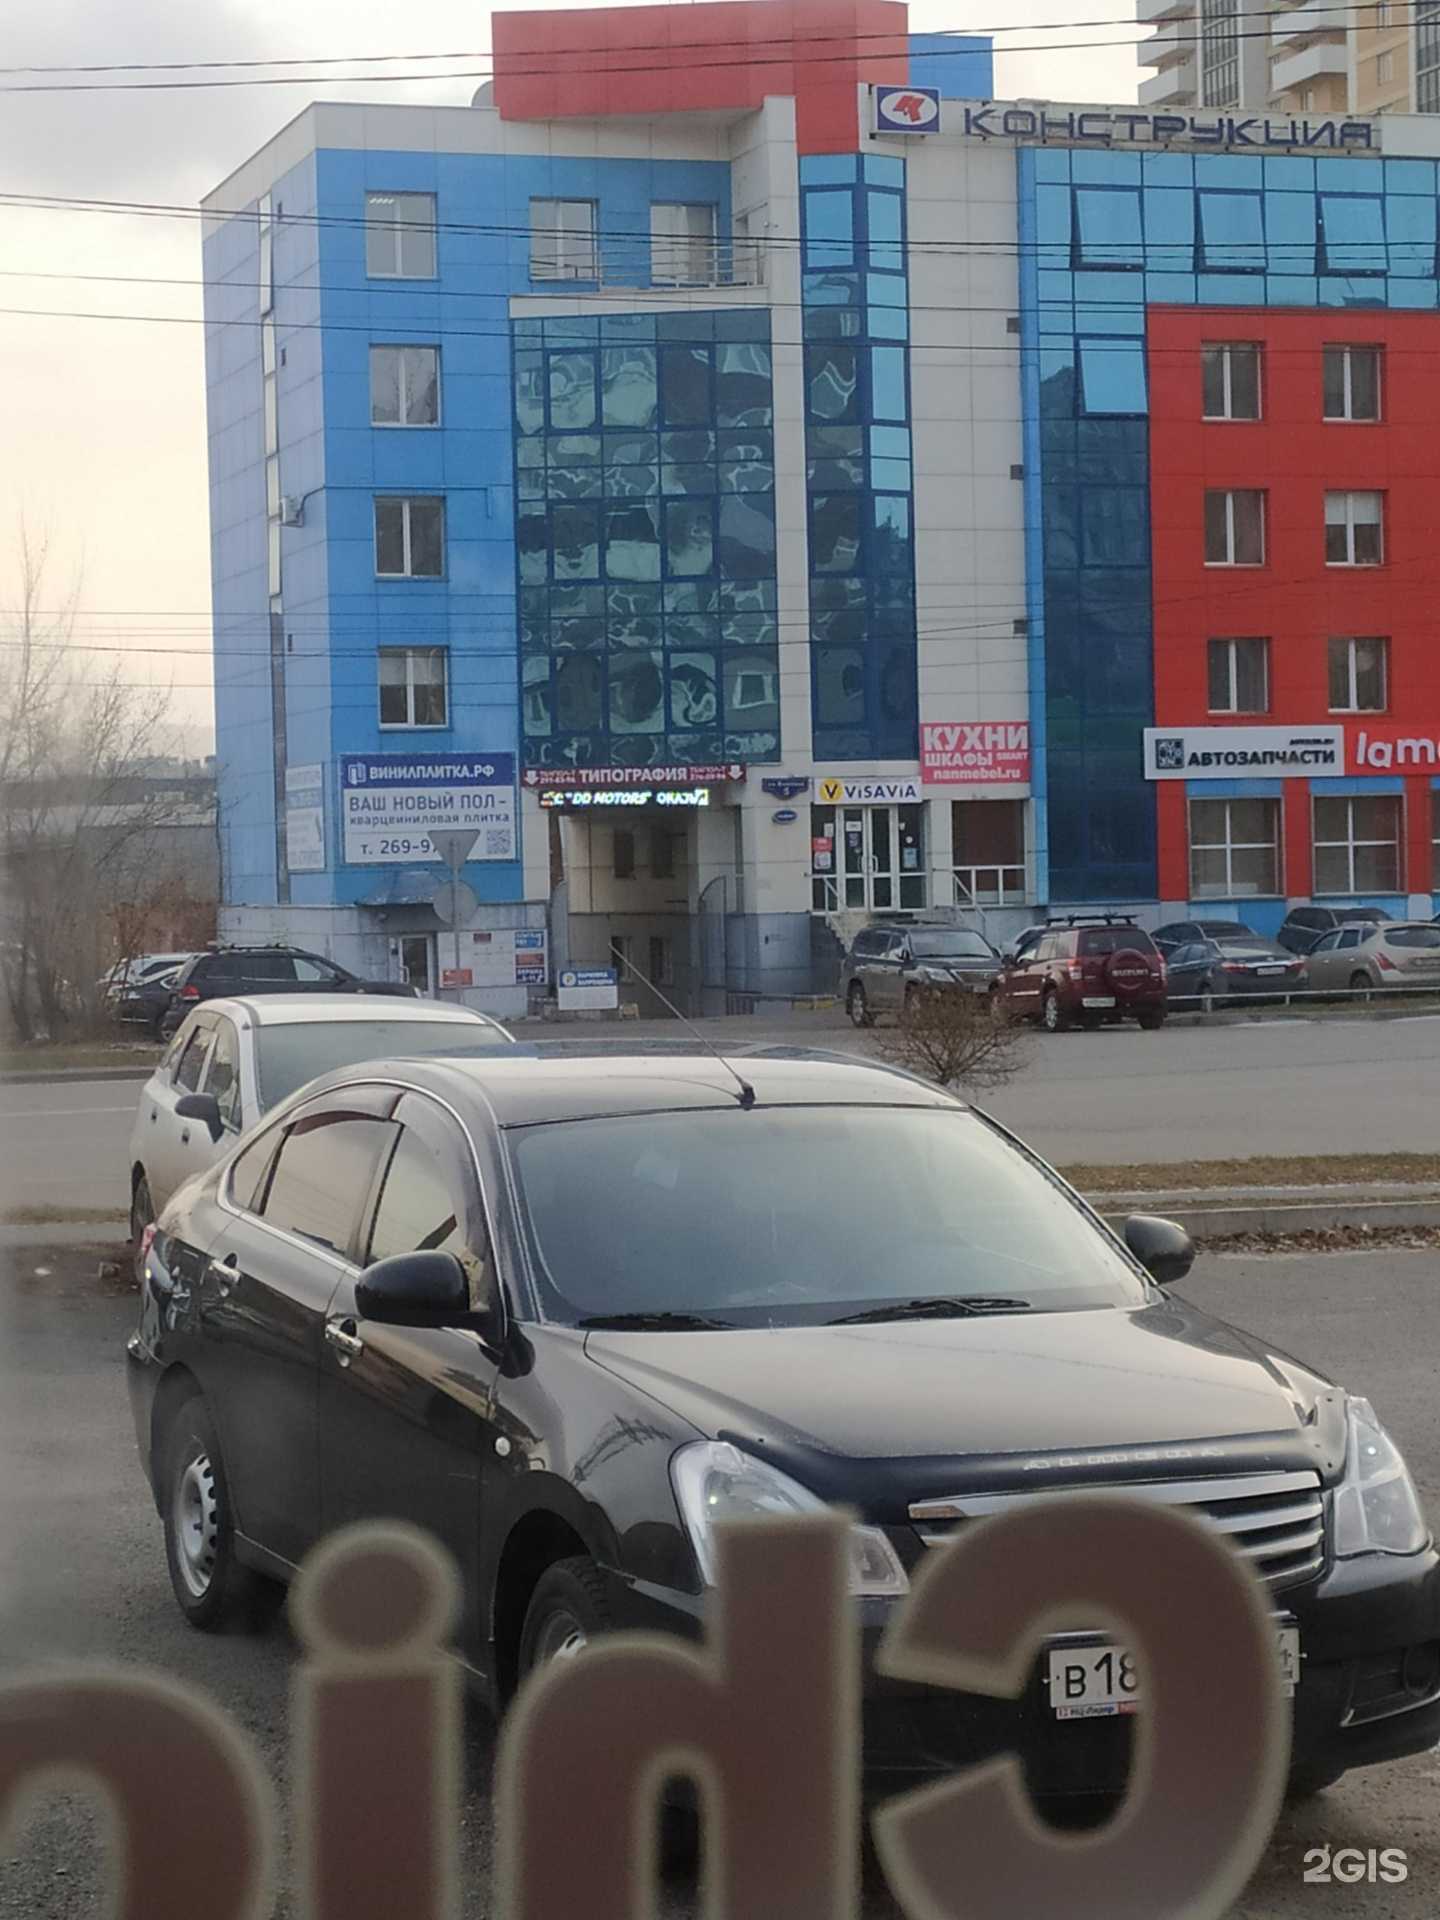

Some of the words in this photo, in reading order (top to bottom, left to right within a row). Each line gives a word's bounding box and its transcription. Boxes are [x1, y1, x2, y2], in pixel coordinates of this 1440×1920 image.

[964, 106, 1373, 148] КОНСТРУКЦИЯ
[923, 726, 1029, 751] КУХНИ
[1187, 749, 1336, 767] АВТОЗАПЧАСТИ
[1355, 732, 1440, 768] lam
[925, 752, 993, 767] ШКАФЫ
[369, 764, 495, 781] ВИНИЛПЛИТКА.РФ
[579, 767, 688, 784] ТИПОГРАФИЯ
[933, 766, 1020, 780] nanmebel.ru
[349, 796, 386, 812] ВАШ
[393, 791, 454, 811] НОВЫЙ
[464, 812, 510, 824] плитка
